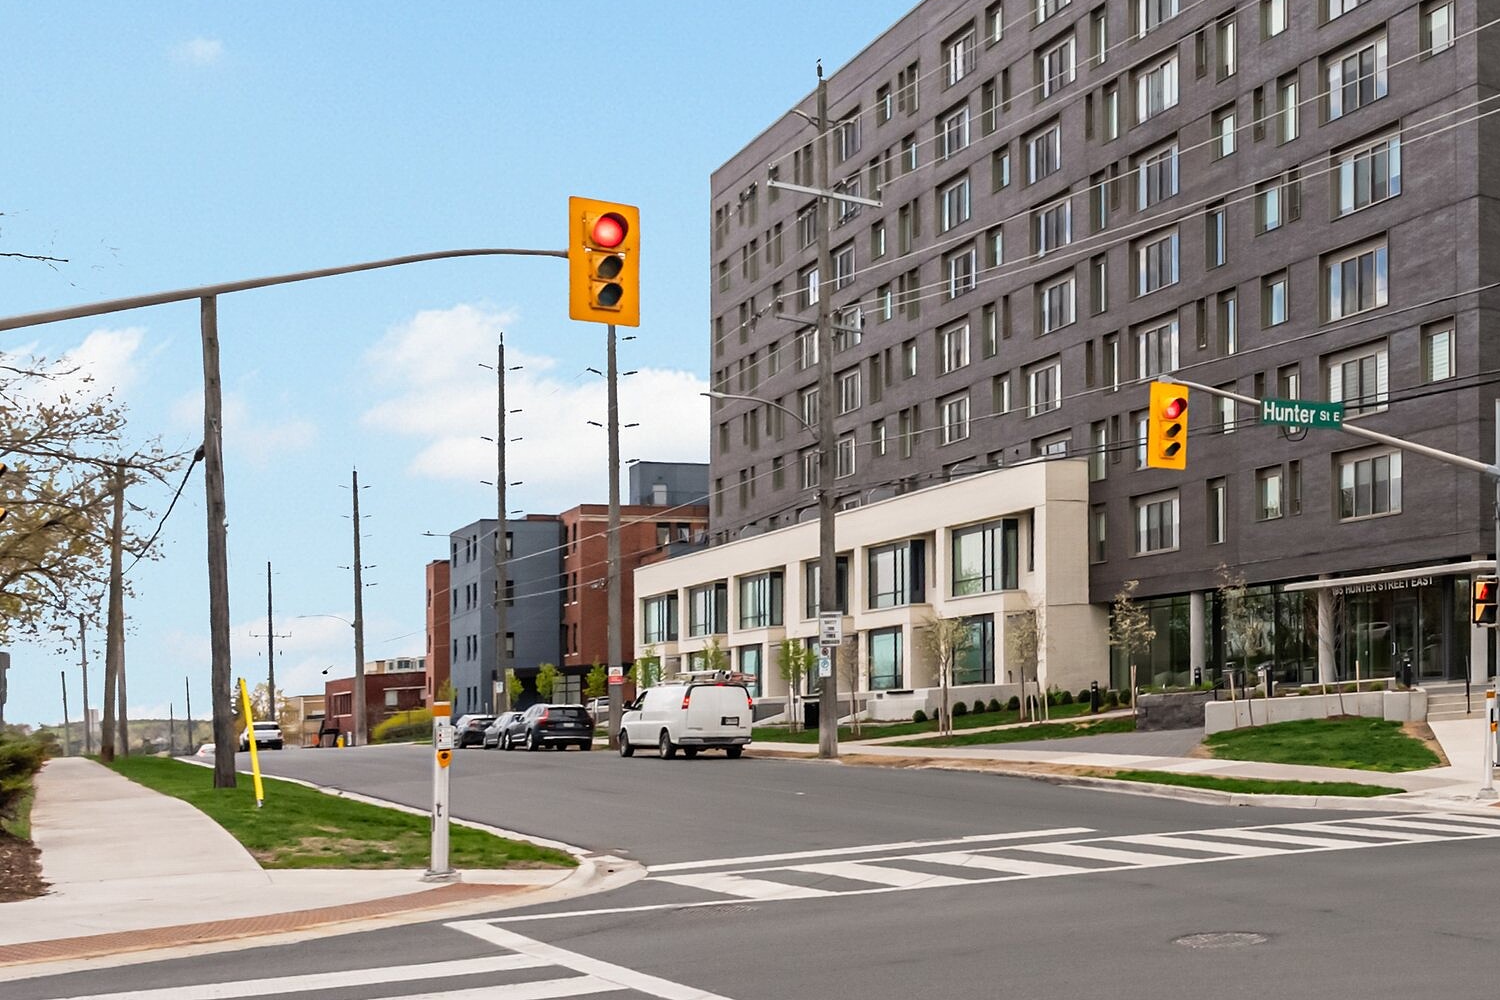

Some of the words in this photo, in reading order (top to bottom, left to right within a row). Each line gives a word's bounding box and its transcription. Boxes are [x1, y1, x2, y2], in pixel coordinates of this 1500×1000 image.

[1263, 401, 1316, 423] Hunter
[1320, 411, 1330, 421] St
[1334, 411, 1341, 421] E
[1345, 582, 1376, 595] HUNTER
[1378, 579, 1409, 591] STREET
[1411, 576, 1433, 587] EAST
